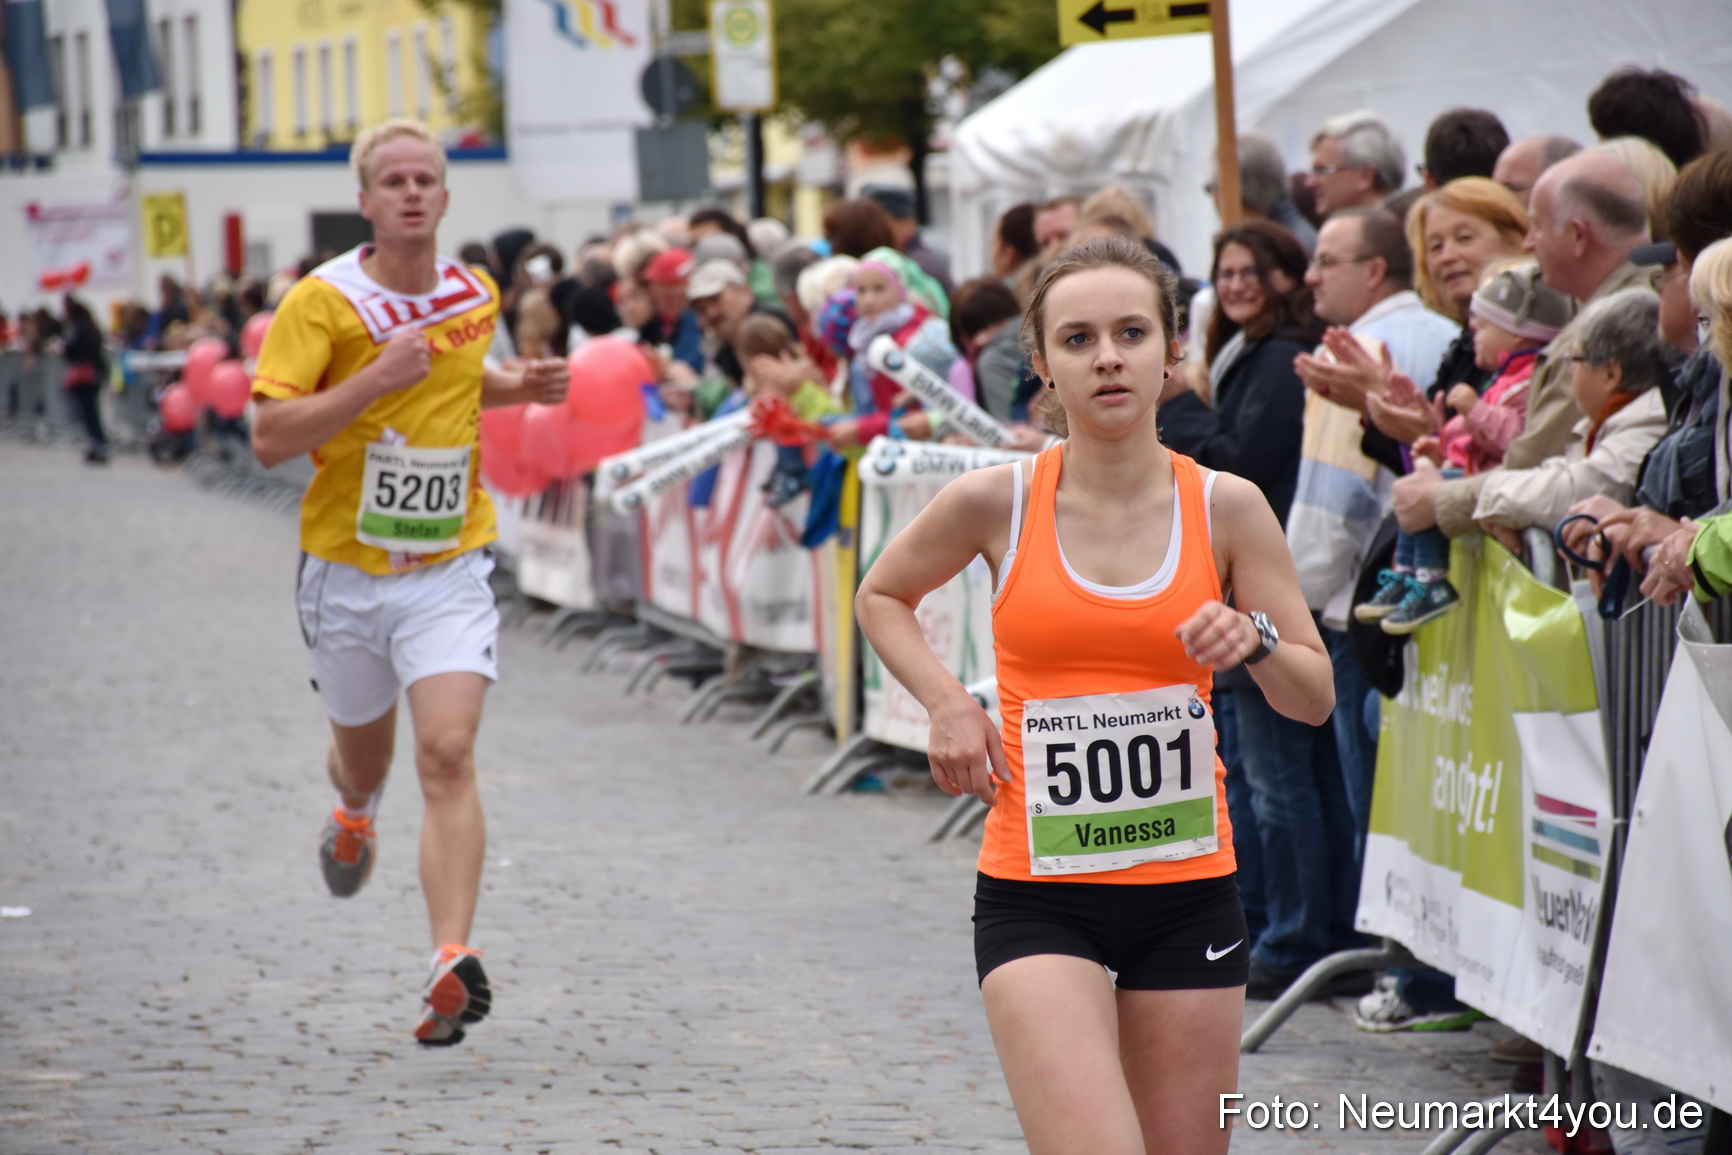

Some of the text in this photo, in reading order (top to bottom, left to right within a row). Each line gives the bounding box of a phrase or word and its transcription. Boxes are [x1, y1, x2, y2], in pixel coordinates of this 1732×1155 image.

[375, 470, 462, 513] 5203
[393, 521, 441, 539] Stefan
[1026, 705, 1182, 733] PARTL Neumarkt
[1045, 728, 1192, 806] 5001
[1074, 816, 1176, 848] Vanessa
